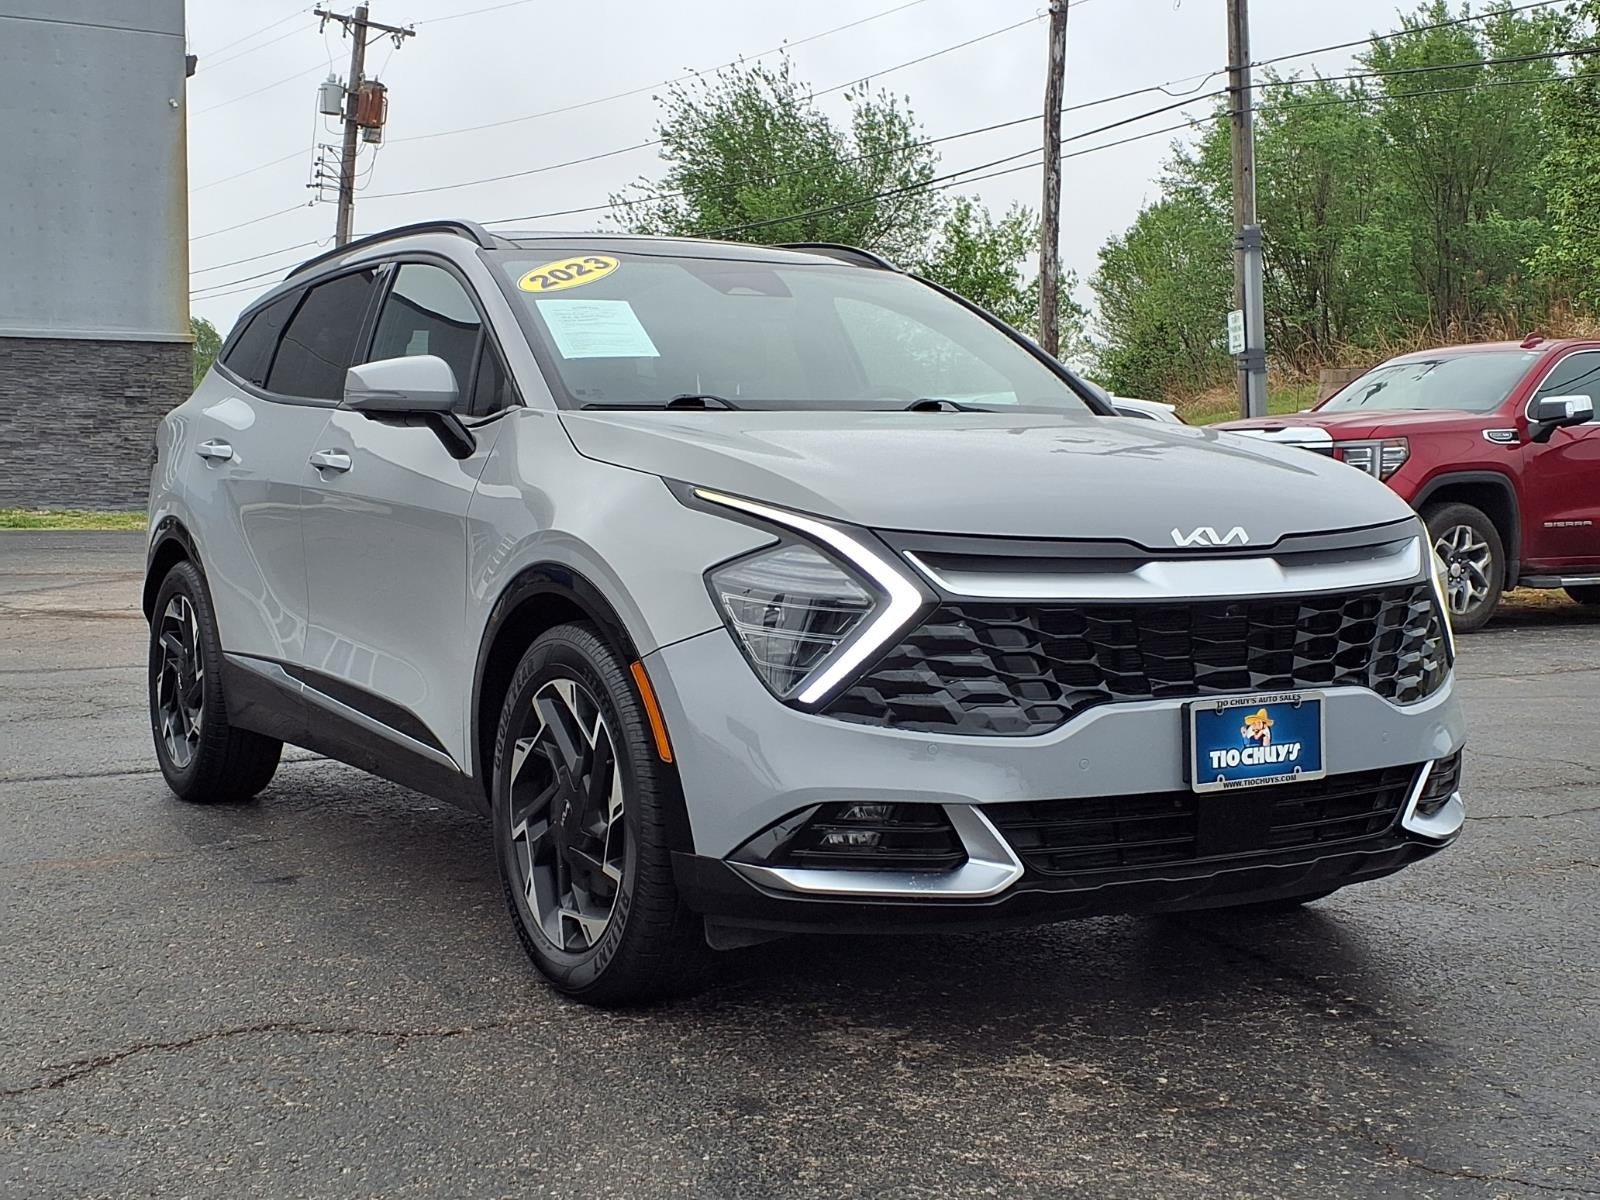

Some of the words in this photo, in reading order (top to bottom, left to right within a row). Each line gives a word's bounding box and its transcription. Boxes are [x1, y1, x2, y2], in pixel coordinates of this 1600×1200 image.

[529, 257, 611, 289] 2023
[1171, 526, 1250, 547] KIA
[1216, 699, 1229, 707] TIO
[1230, 697, 1257, 706] CHUY'S
[1259, 695, 1278, 703] AUTO
[1210, 749, 1241, 769] TIO
[1241, 743, 1301, 765] CHUY'S
[1223, 774, 1297, 788] WWW.TIOCHUYS.COM
[592, 891, 632, 976] RELIANT
